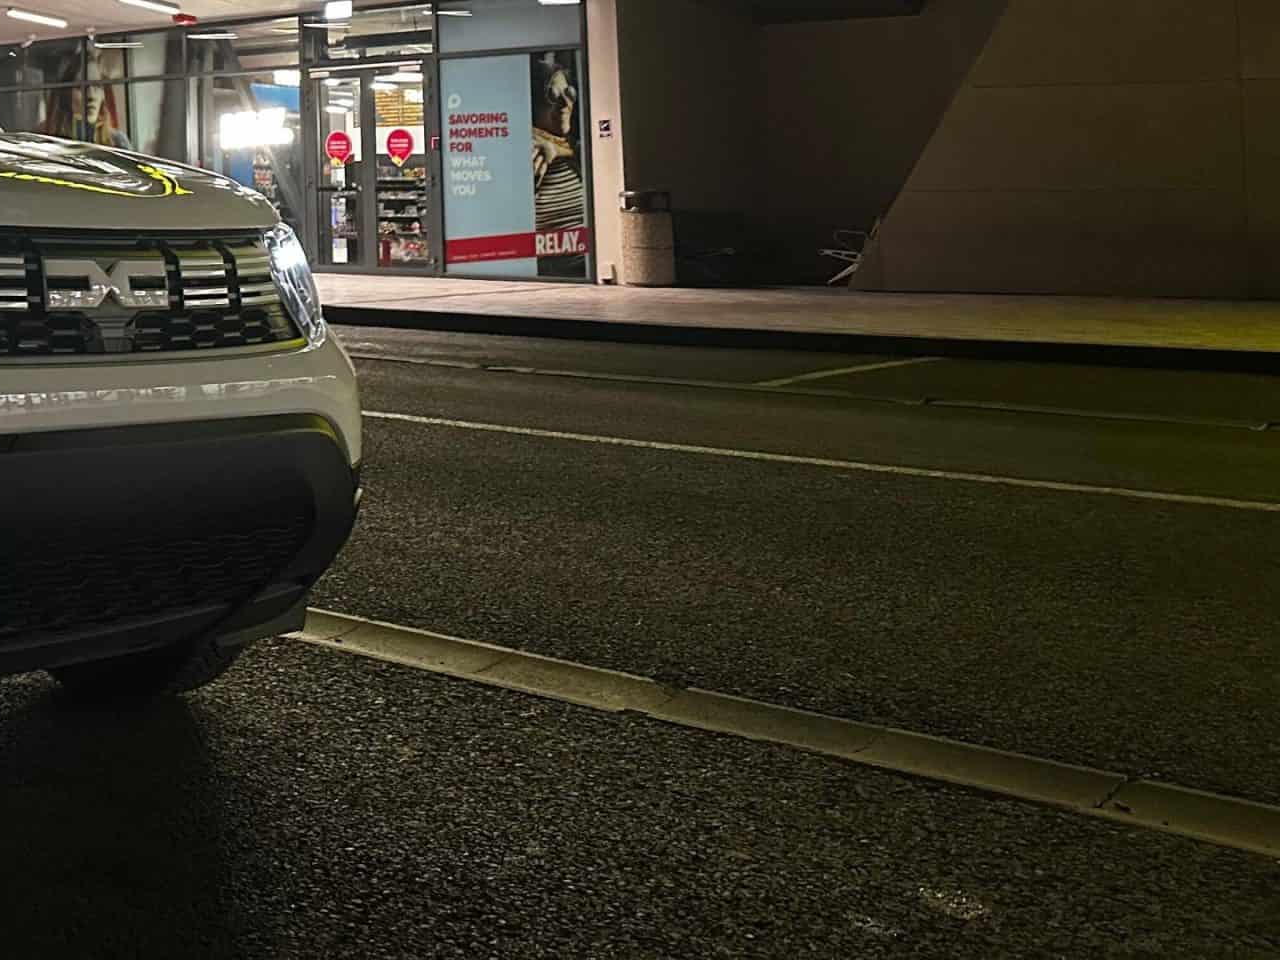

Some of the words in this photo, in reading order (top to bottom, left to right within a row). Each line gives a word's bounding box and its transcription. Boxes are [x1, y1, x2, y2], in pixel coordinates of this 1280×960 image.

[448, 112, 508, 125] SAVORING
[449, 127, 509, 139] MOMENTS
[449, 142, 473, 153] FOR
[451, 156, 487, 168] WHAT
[451, 170, 491, 182] MOVES
[451, 184, 476, 196] YOU
[536, 230, 580, 255] RELAY
